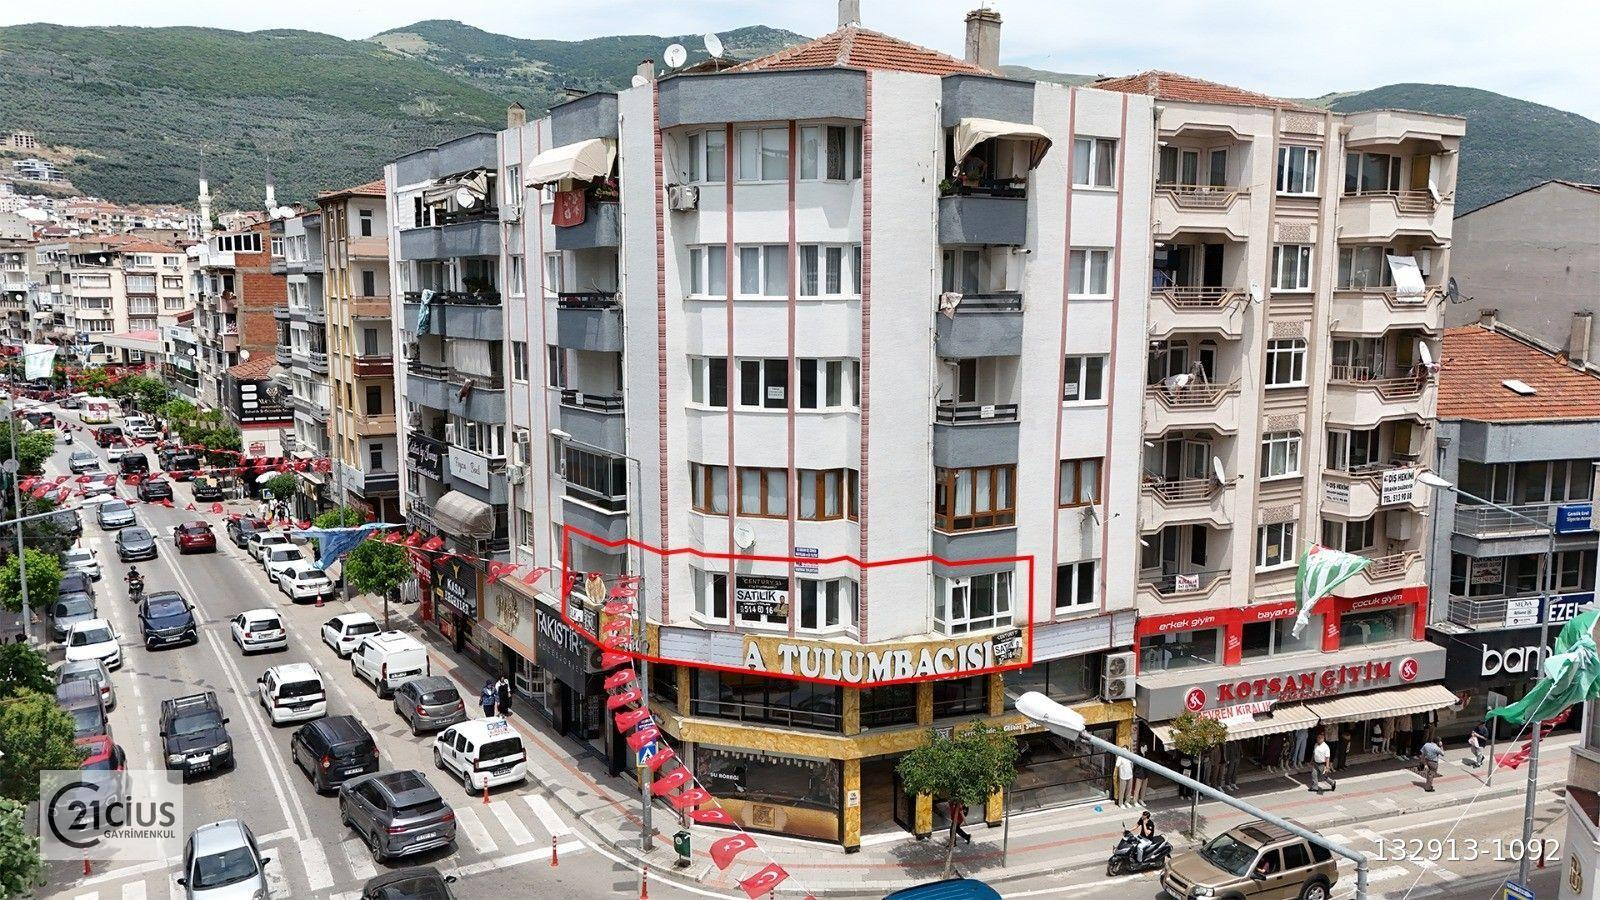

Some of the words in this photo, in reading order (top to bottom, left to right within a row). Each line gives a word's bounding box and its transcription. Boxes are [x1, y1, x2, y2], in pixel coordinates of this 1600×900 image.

[737, 590, 776, 602] SATILIK
[1352, 598, 1381, 609] çocuk
[1382, 594, 1403, 605] giyim
[744, 605, 756, 613] 514
[1257, 608, 1287, 619] bayan
[1159, 619, 1190, 631] erkek
[1191, 615, 1215, 629] giyim
[744, 641, 767, 672] A
[777, 641, 993, 683] TULUMBACISI
[1216, 672, 1316, 702] KOTSAN
[1321, 661, 1392, 688] GİYİM
